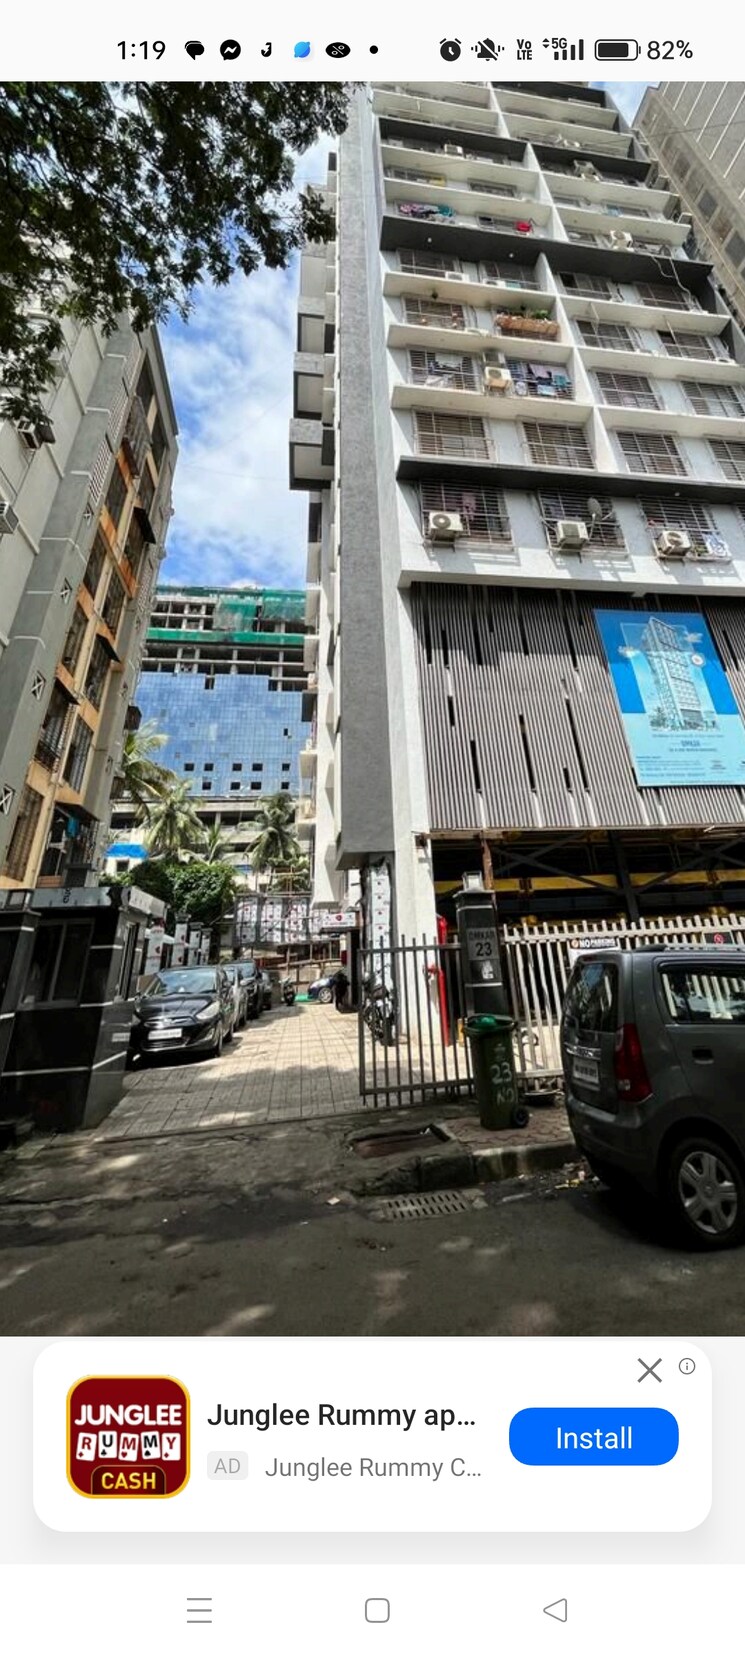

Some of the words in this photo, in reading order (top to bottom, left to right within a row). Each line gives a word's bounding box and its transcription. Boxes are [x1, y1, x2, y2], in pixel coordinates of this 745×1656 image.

[475, 942, 492, 957] 23
[580, 938, 591, 948] NO
[490, 1062, 512, 1084] 23
